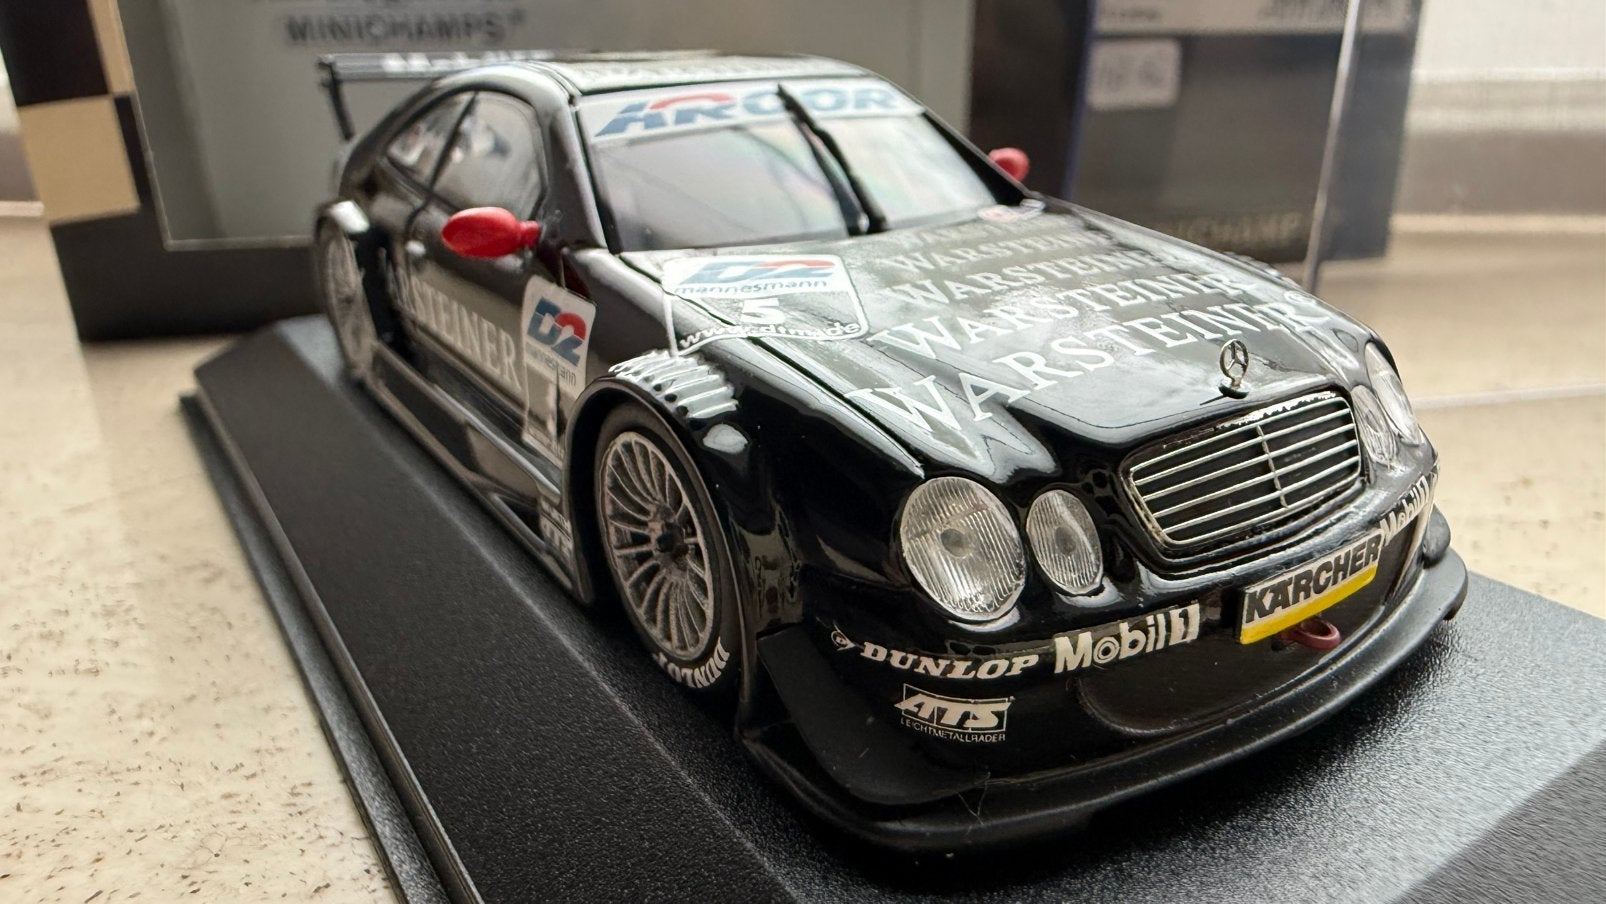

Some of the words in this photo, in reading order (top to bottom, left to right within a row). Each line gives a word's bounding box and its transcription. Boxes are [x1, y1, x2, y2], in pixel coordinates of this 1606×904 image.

[674, 279, 828, 294] mannesmann
[679, 259, 836, 286] D2
[740, 297, 786, 326] 5
[527, 296, 587, 368] D2
[844, 302, 1331, 432] WARSTEINER
[859, 641, 1040, 680] DUNLOP
[894, 692, 1013, 729] ATS
